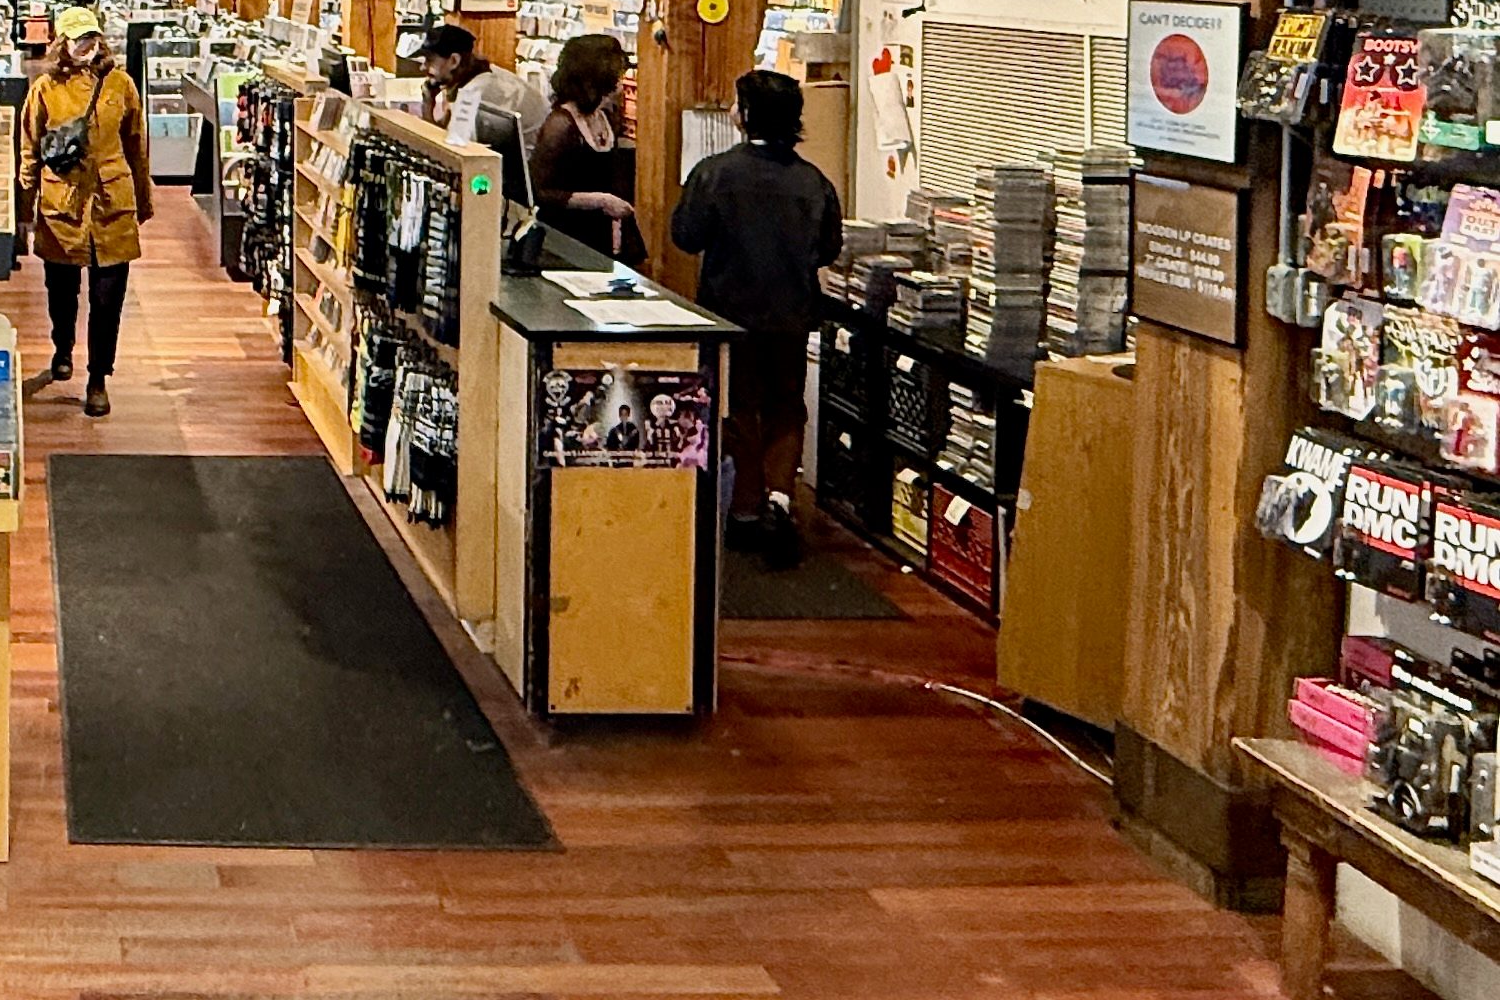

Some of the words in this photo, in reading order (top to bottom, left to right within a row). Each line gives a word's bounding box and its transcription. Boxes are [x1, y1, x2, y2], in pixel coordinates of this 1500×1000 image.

[1139, 12, 1170, 26] CAN'T
[1364, 38, 1422, 54] BOOTSY
[1466, 215, 1498, 229] OUT
[1285, 434, 1352, 492] KWAME
[1344, 472, 1420, 523] RUN
[1343, 499, 1418, 549] DMC
